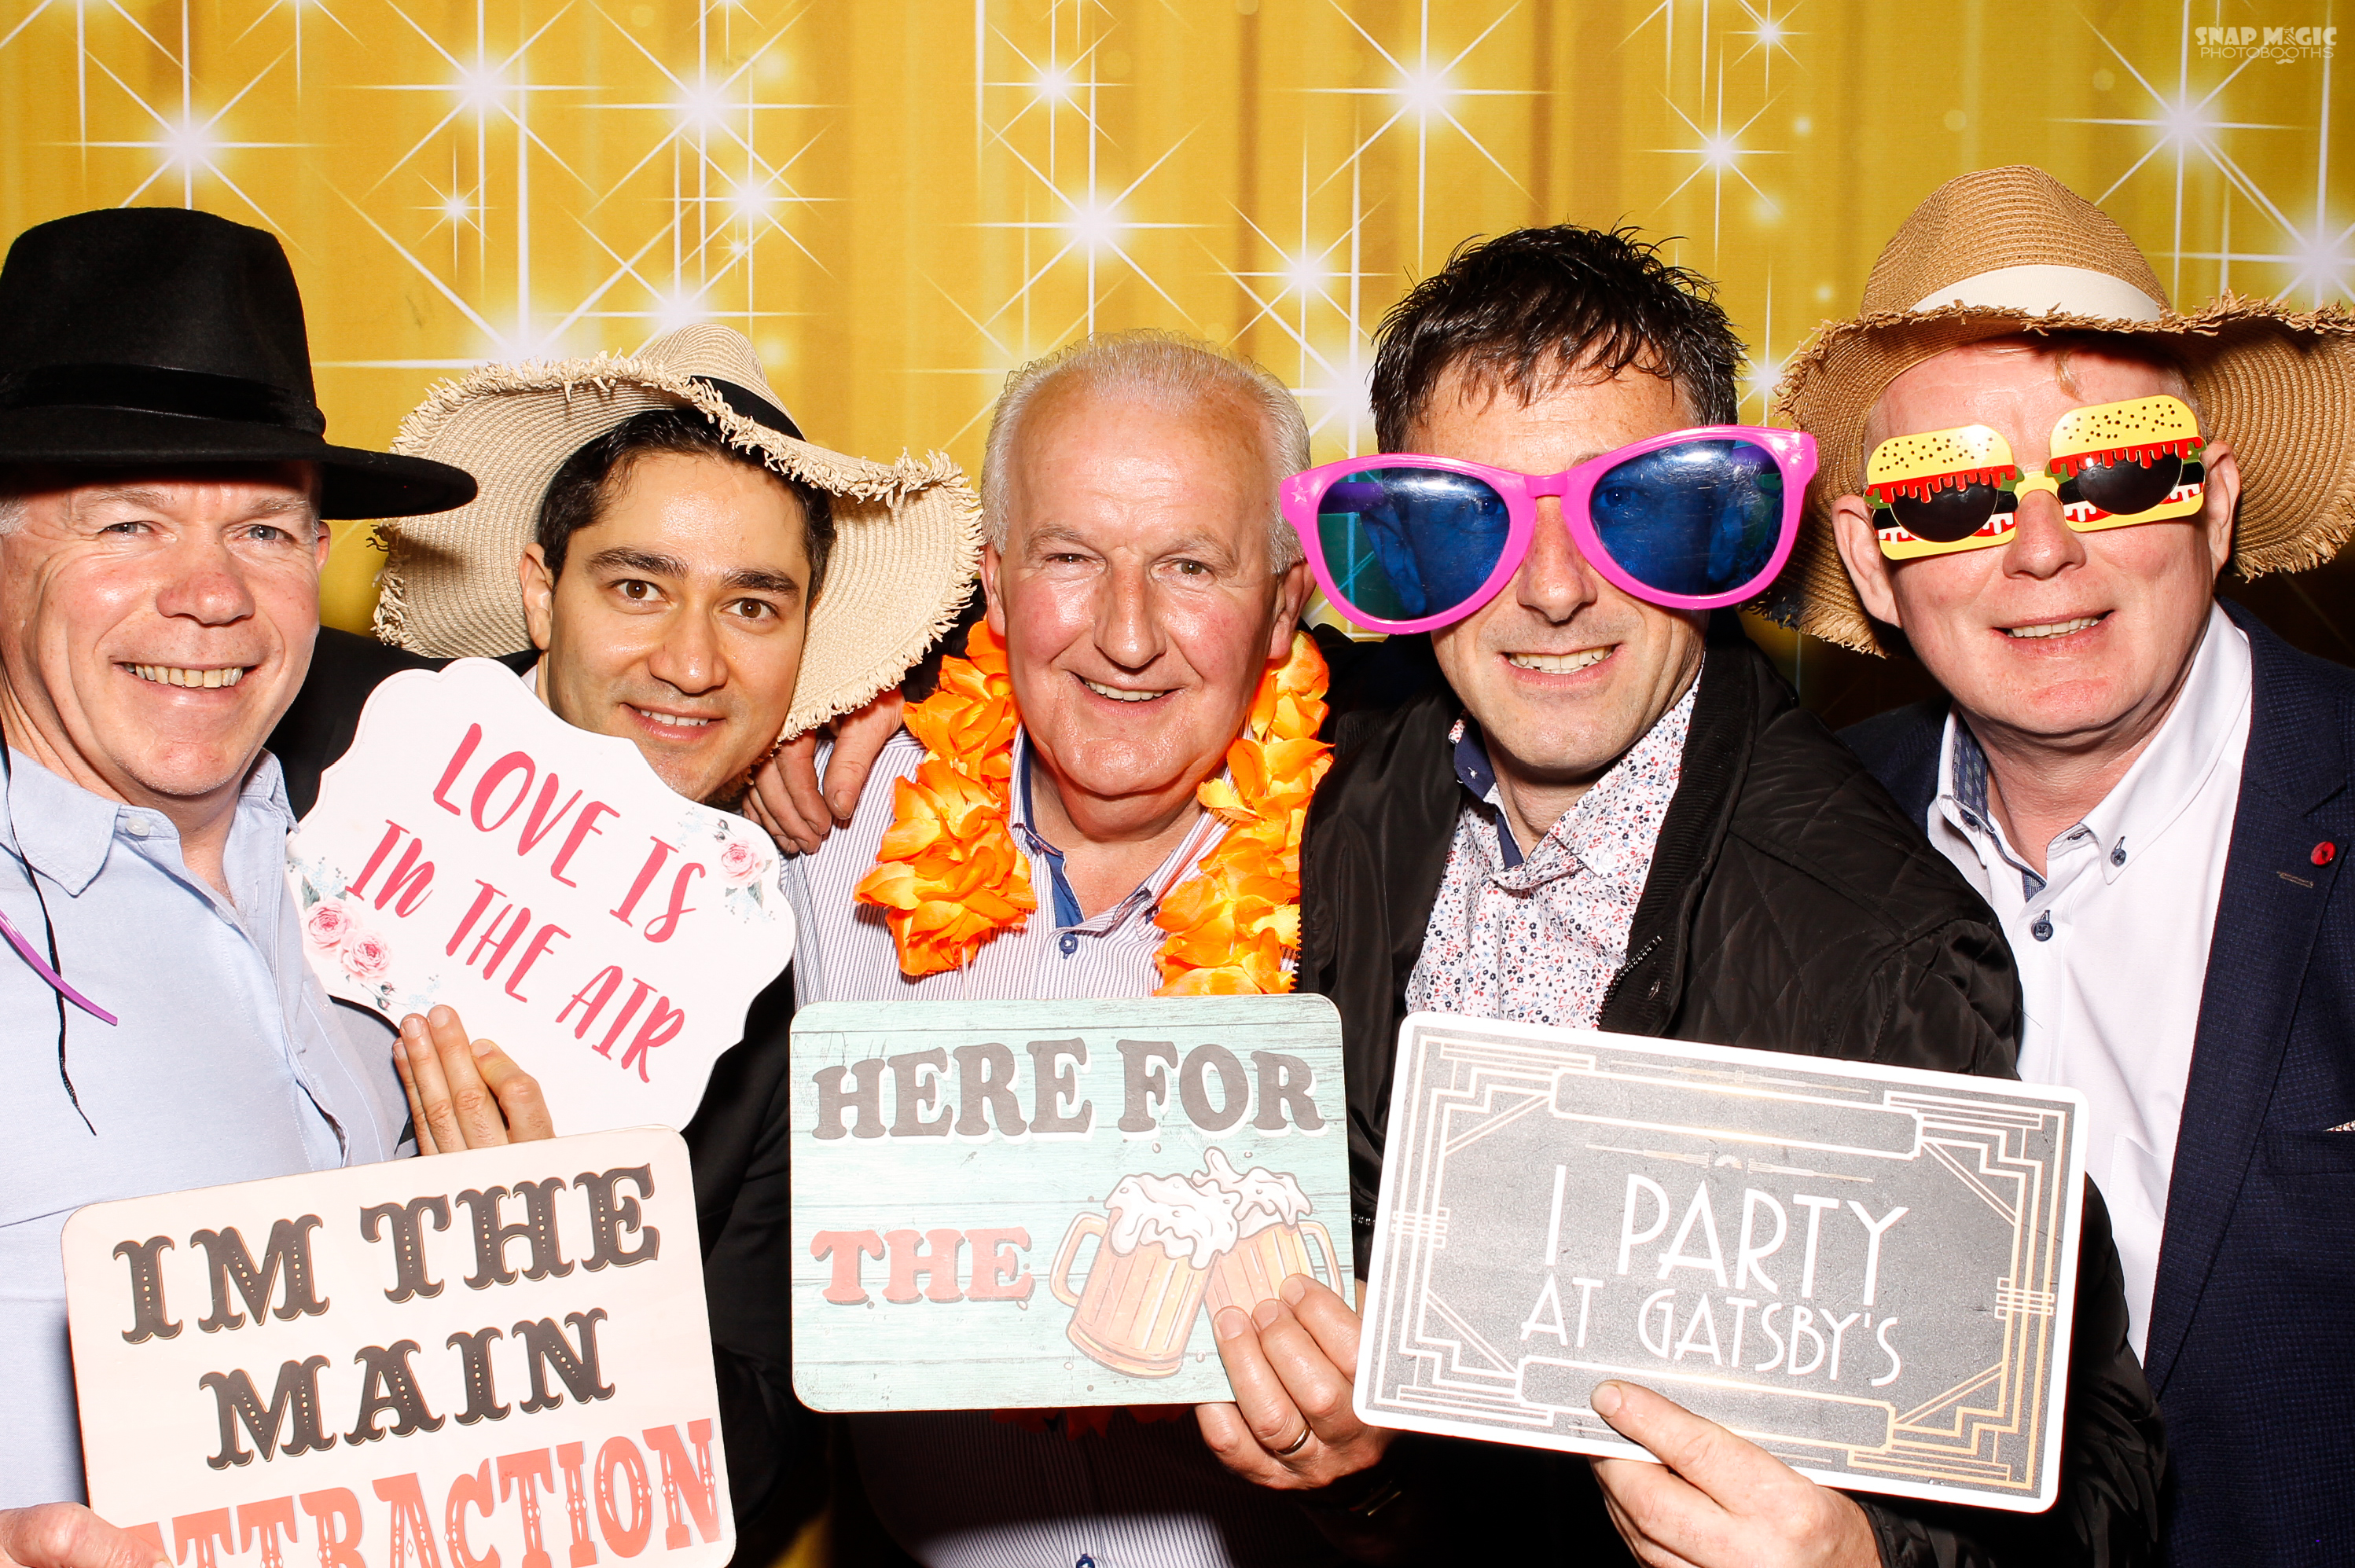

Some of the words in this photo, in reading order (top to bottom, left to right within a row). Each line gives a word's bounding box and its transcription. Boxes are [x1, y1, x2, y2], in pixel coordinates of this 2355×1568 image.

[433, 722, 620, 888] LOVE
[610, 835, 706, 943] IS
[344, 819, 435, 918] IN
[446, 879, 571, 1003] THE
[555, 964, 685, 1083] AIR
[811, 1037, 1096, 1146] HERE
[1115, 1039, 1329, 1137] FOR
[112, 1214, 329, 1345] IM
[359, 1162, 660, 1305] THE
[810, 1226, 1036, 1305] THE
[1545, 1164, 1567, 1266] I
[1617, 1173, 1910, 1306] PARTY
[199, 1307, 615, 1471] MAIN
[1519, 1272, 1604, 1349] AT
[1637, 1288, 1902, 1386] GATSBY'S
[119, 1417, 722, 1568] TTRACTION
